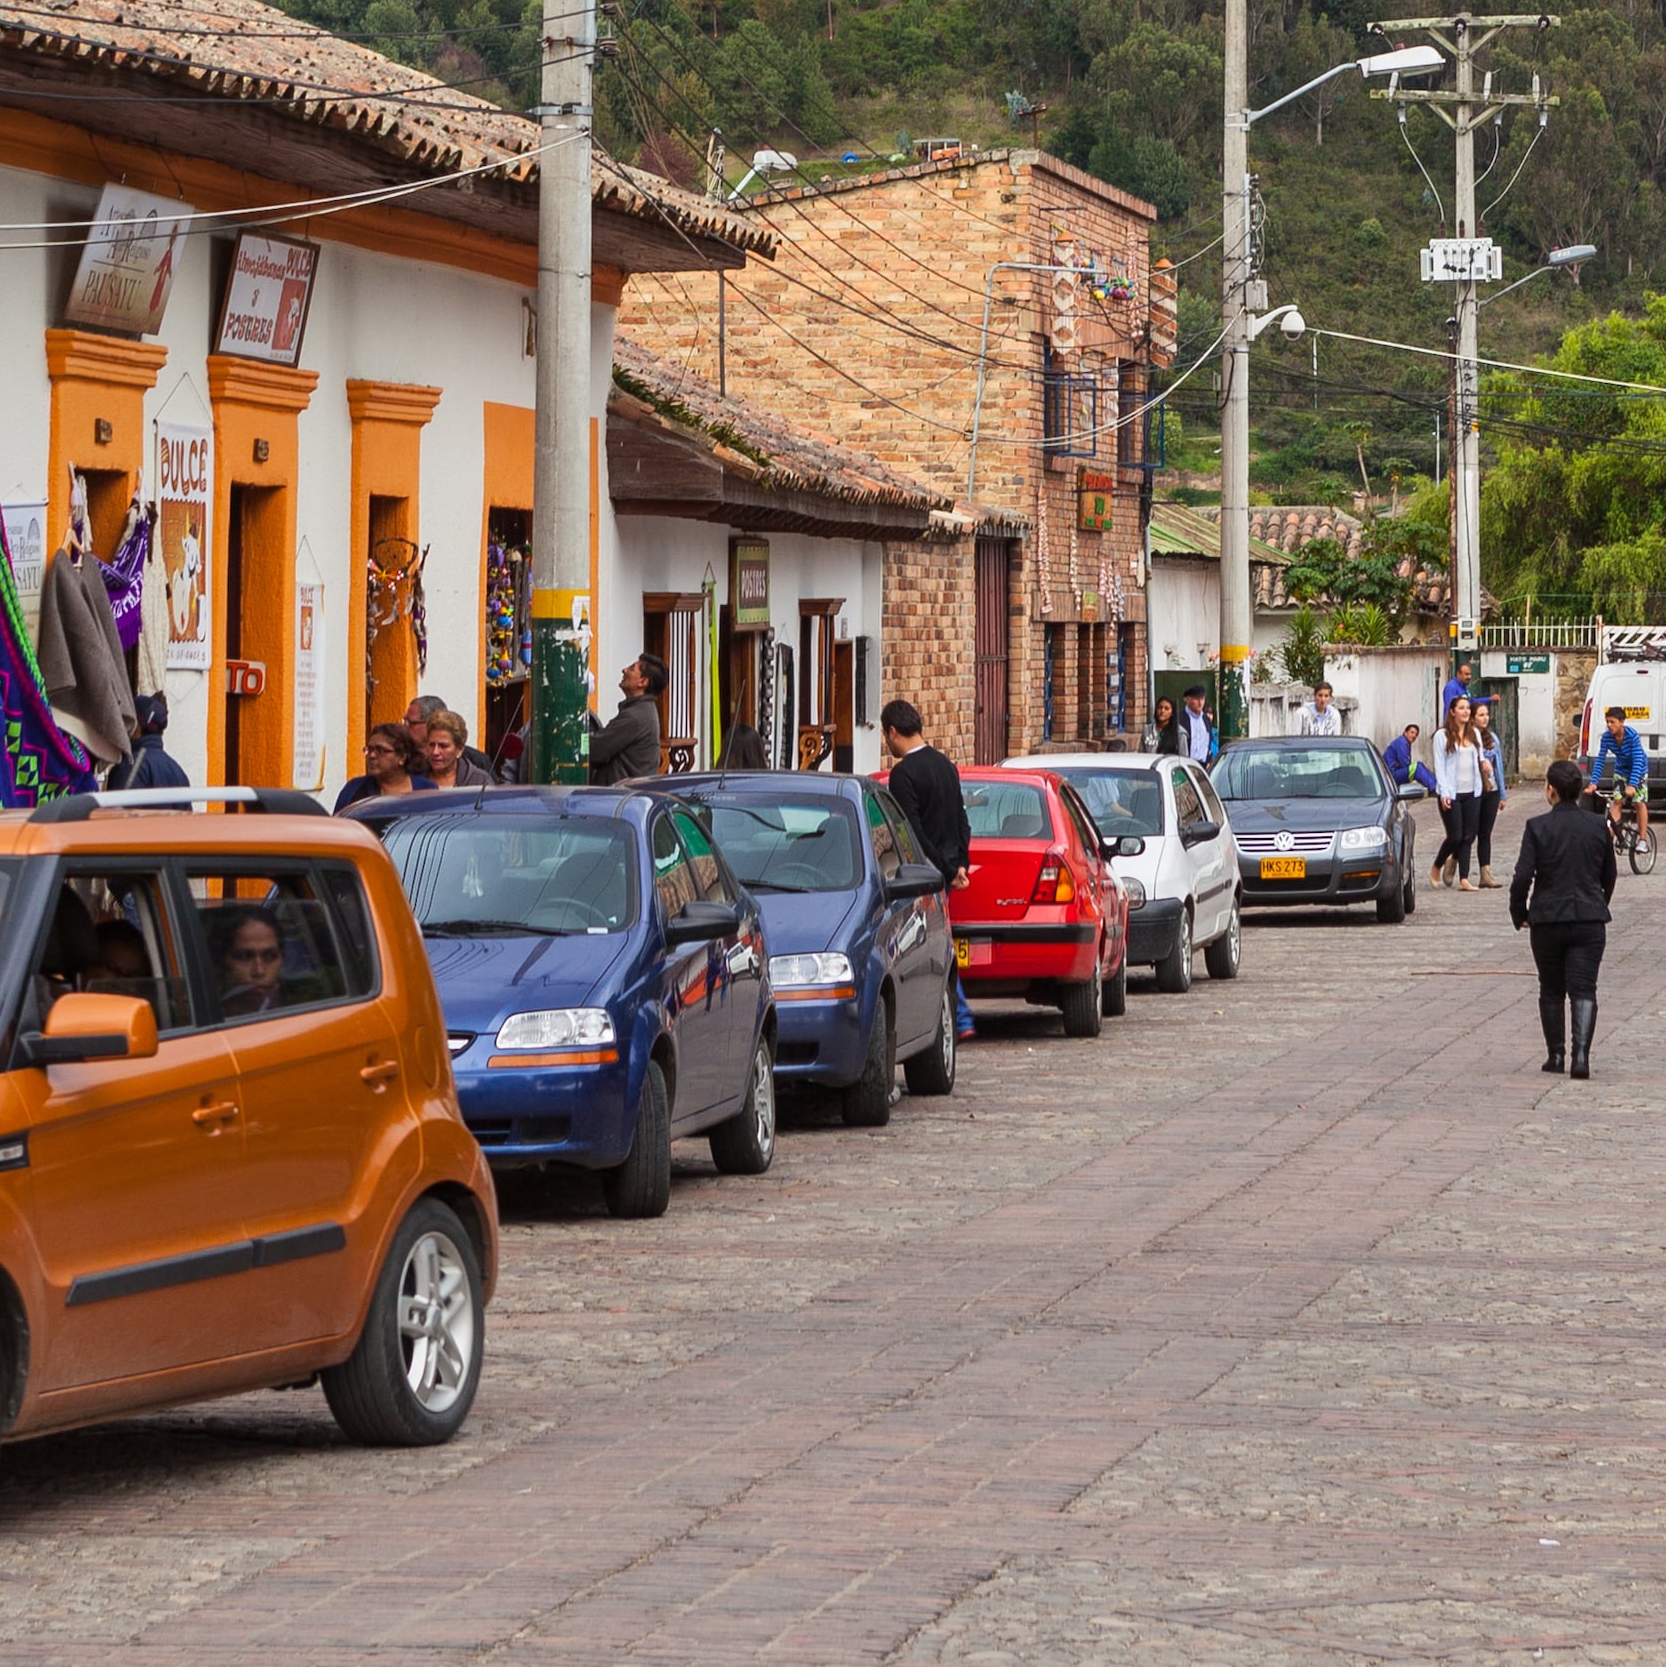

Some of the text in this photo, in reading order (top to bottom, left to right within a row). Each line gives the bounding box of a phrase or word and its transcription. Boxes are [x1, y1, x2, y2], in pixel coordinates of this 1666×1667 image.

[81, 270, 142, 312] PAUSAYU
[224, 312, 273, 345] POSTRES
[161, 437, 207, 496] DULCE
[15, 565, 41, 589] SAYU
[741, 569, 766, 599] POSTRES
